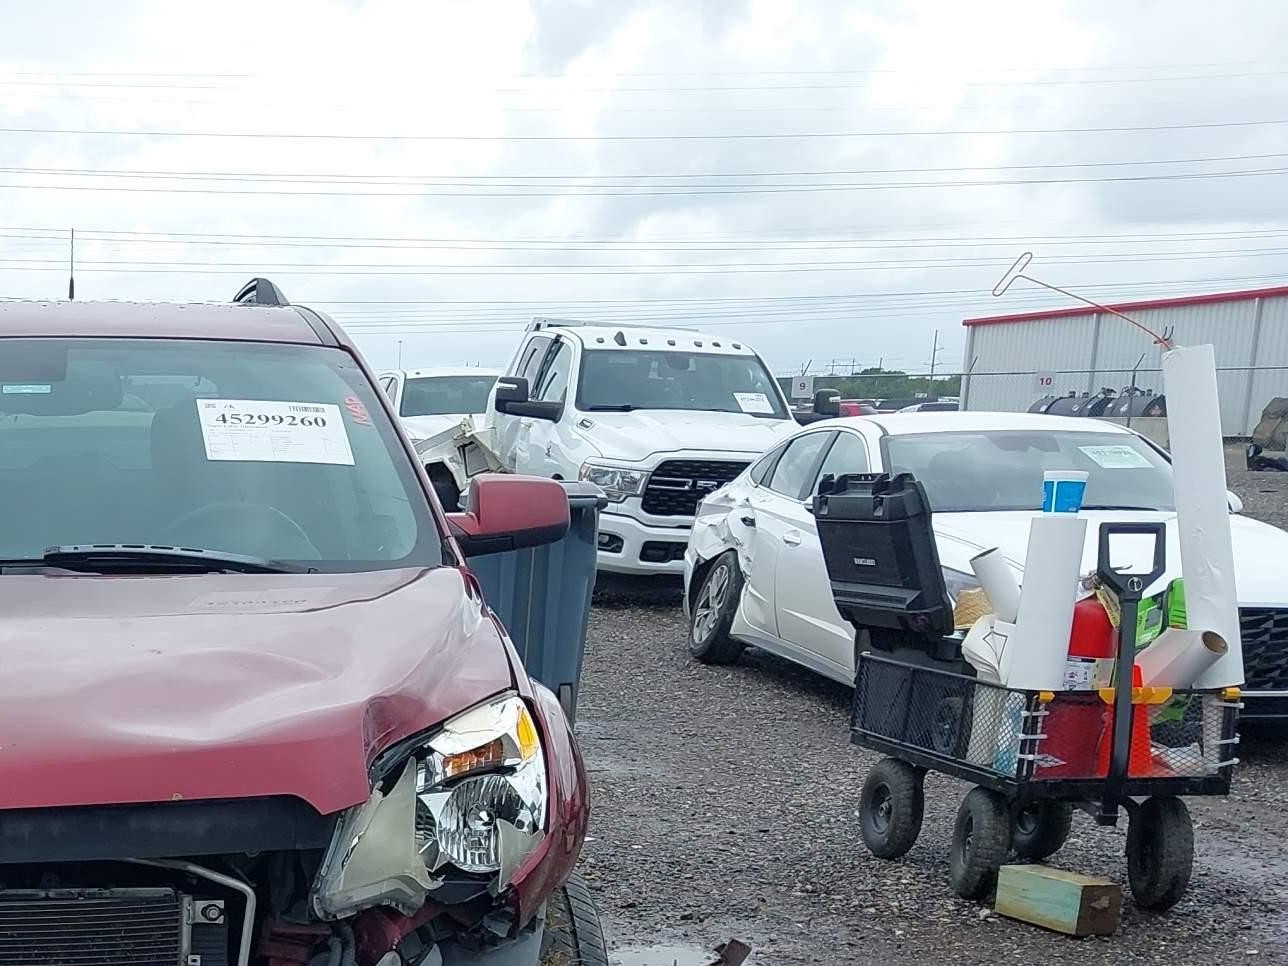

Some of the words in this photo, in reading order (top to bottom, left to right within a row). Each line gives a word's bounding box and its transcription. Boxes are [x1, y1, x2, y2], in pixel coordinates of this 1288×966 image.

[1039, 377, 1052, 386] 10
[799, 382, 806, 391] 9
[215, 412, 327, 428] 45299260
